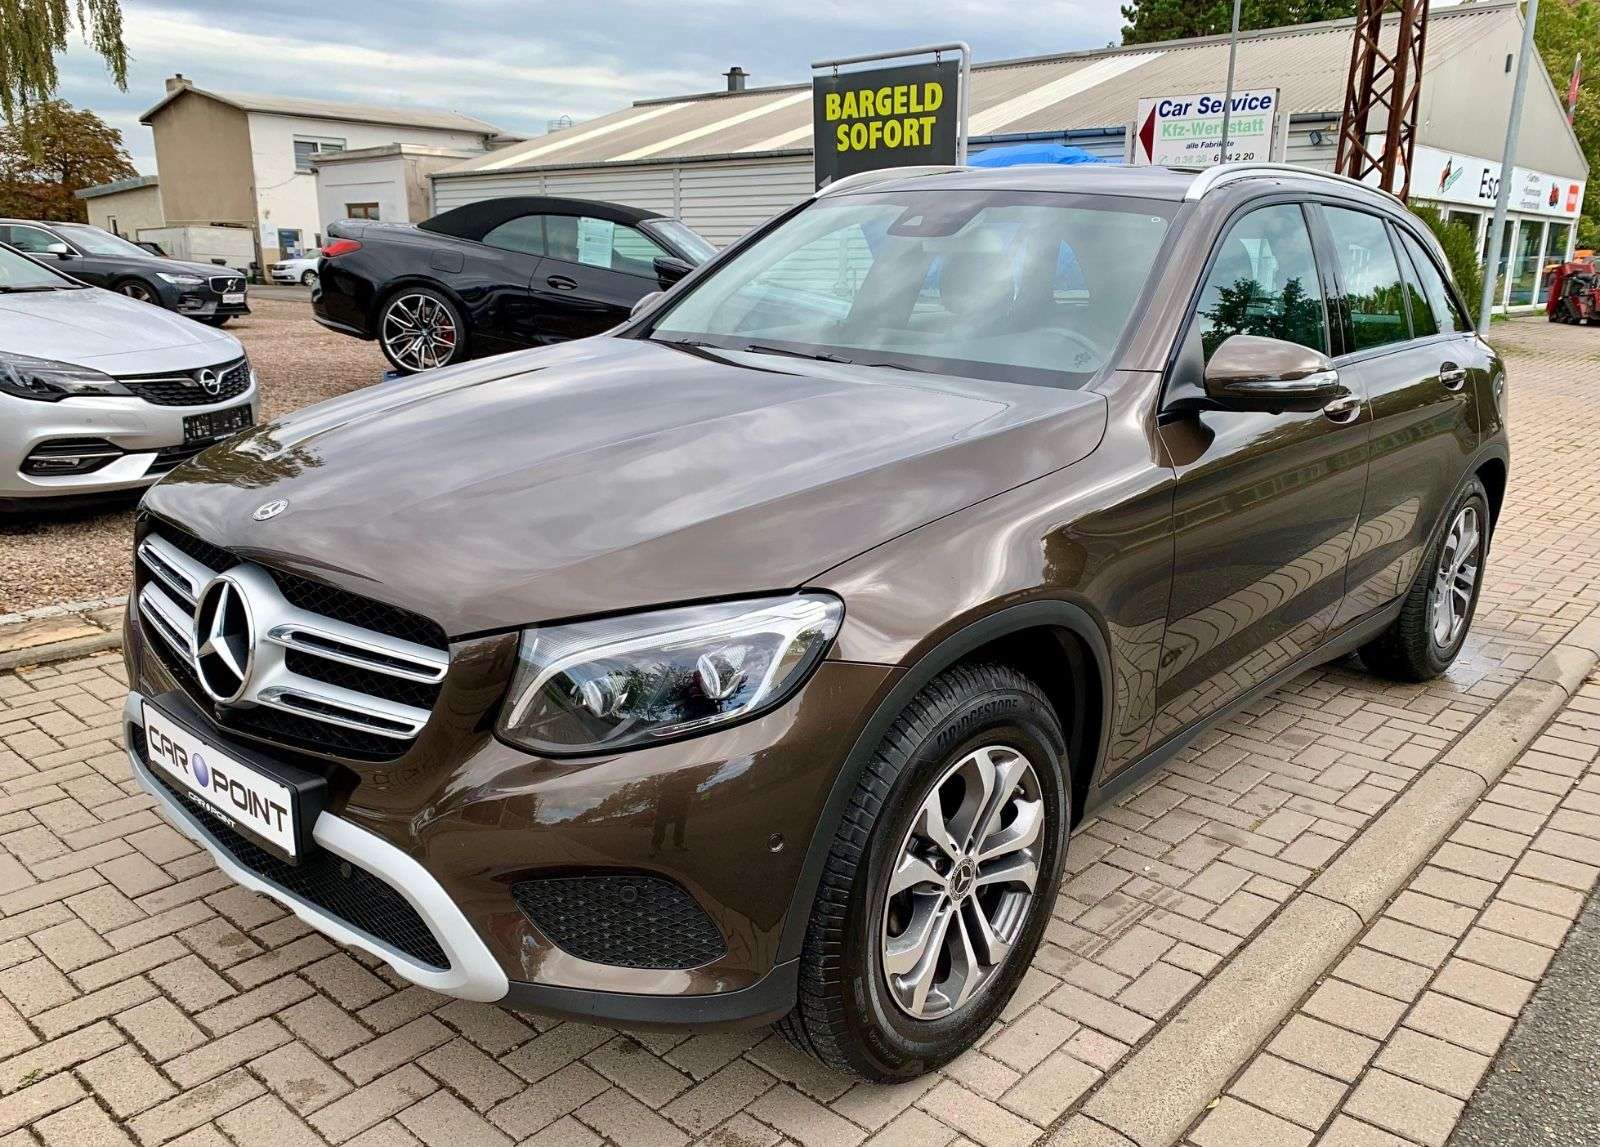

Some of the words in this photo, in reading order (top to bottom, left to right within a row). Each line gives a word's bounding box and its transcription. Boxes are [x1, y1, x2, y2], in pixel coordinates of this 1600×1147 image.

[825, 82, 944, 121] BARGELD
[1158, 100, 1192, 118] Car
[836, 116, 937, 152] SOFORT
[1161, 118, 1265, 138] Kfz-Werstatt
[1200, 140, 1235, 149] Fabrikte
[1213, 153, 1233, 162] 64
[1242, 152, 1255, 161] 20
[1479, 168, 1500, 200] Esc
[149, 725, 189, 775] CAR
[211, 766, 287, 833] POINT
